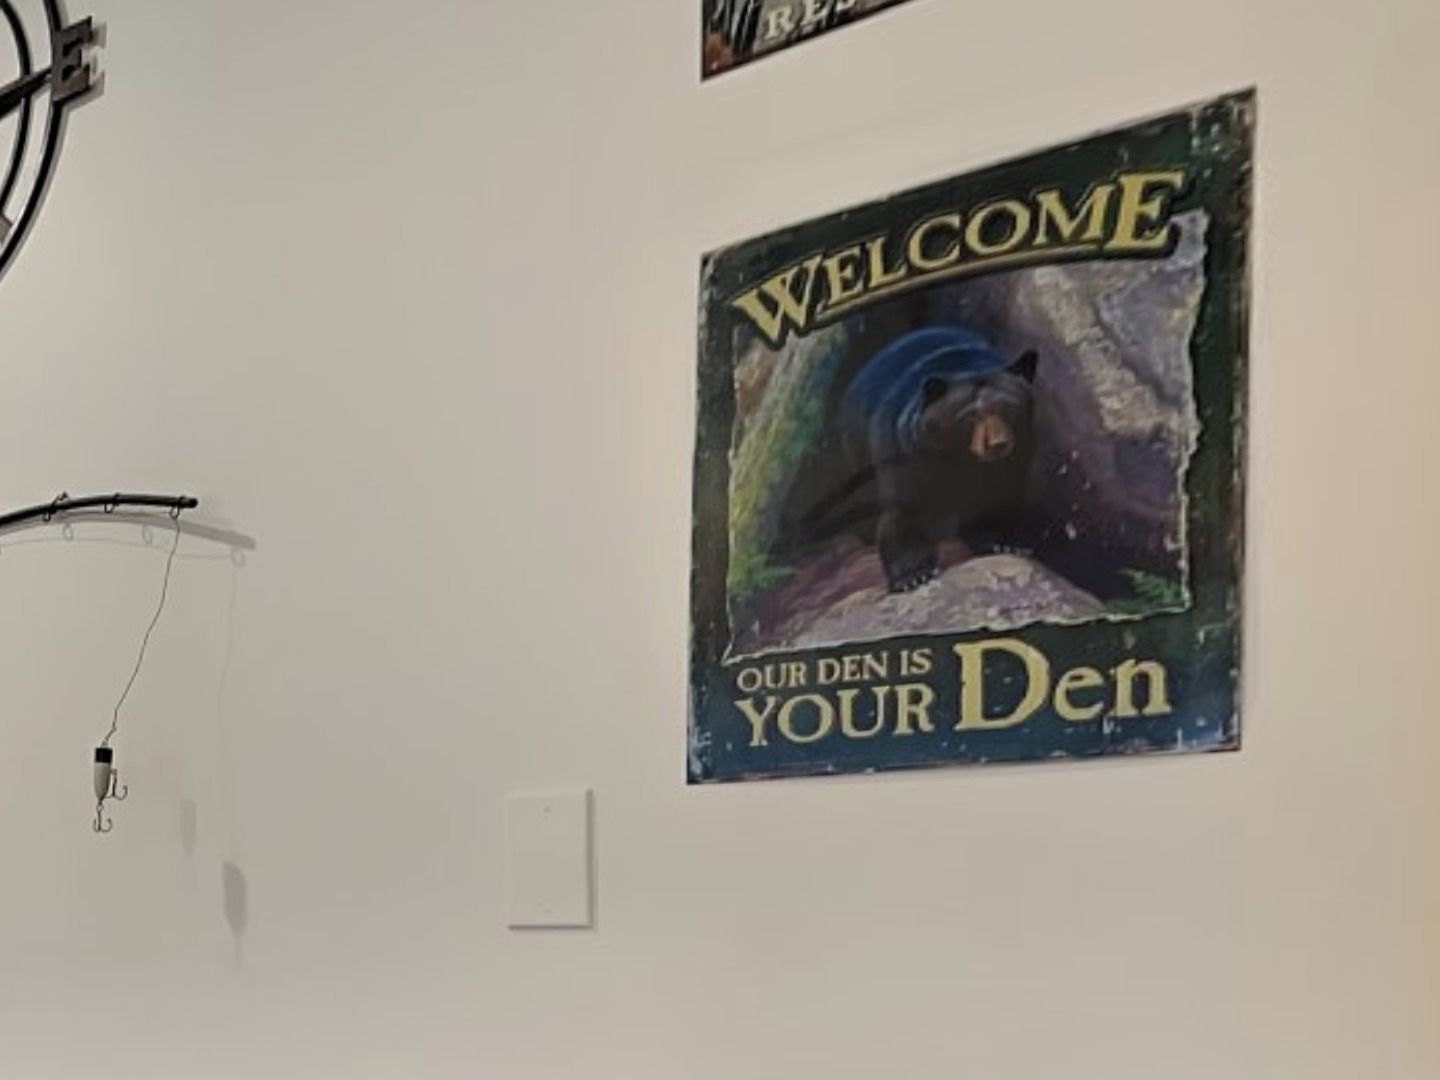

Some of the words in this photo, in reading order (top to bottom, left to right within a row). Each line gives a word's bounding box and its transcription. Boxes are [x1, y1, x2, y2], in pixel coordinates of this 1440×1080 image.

[734, 170, 1184, 345] WELCOME
[734, 683, 935, 748] YOUR
[952, 636, 1173, 732] Den
[736, 661, 807, 693] OUR
[816, 651, 889, 686] DEN
[899, 648, 933, 676] IS
